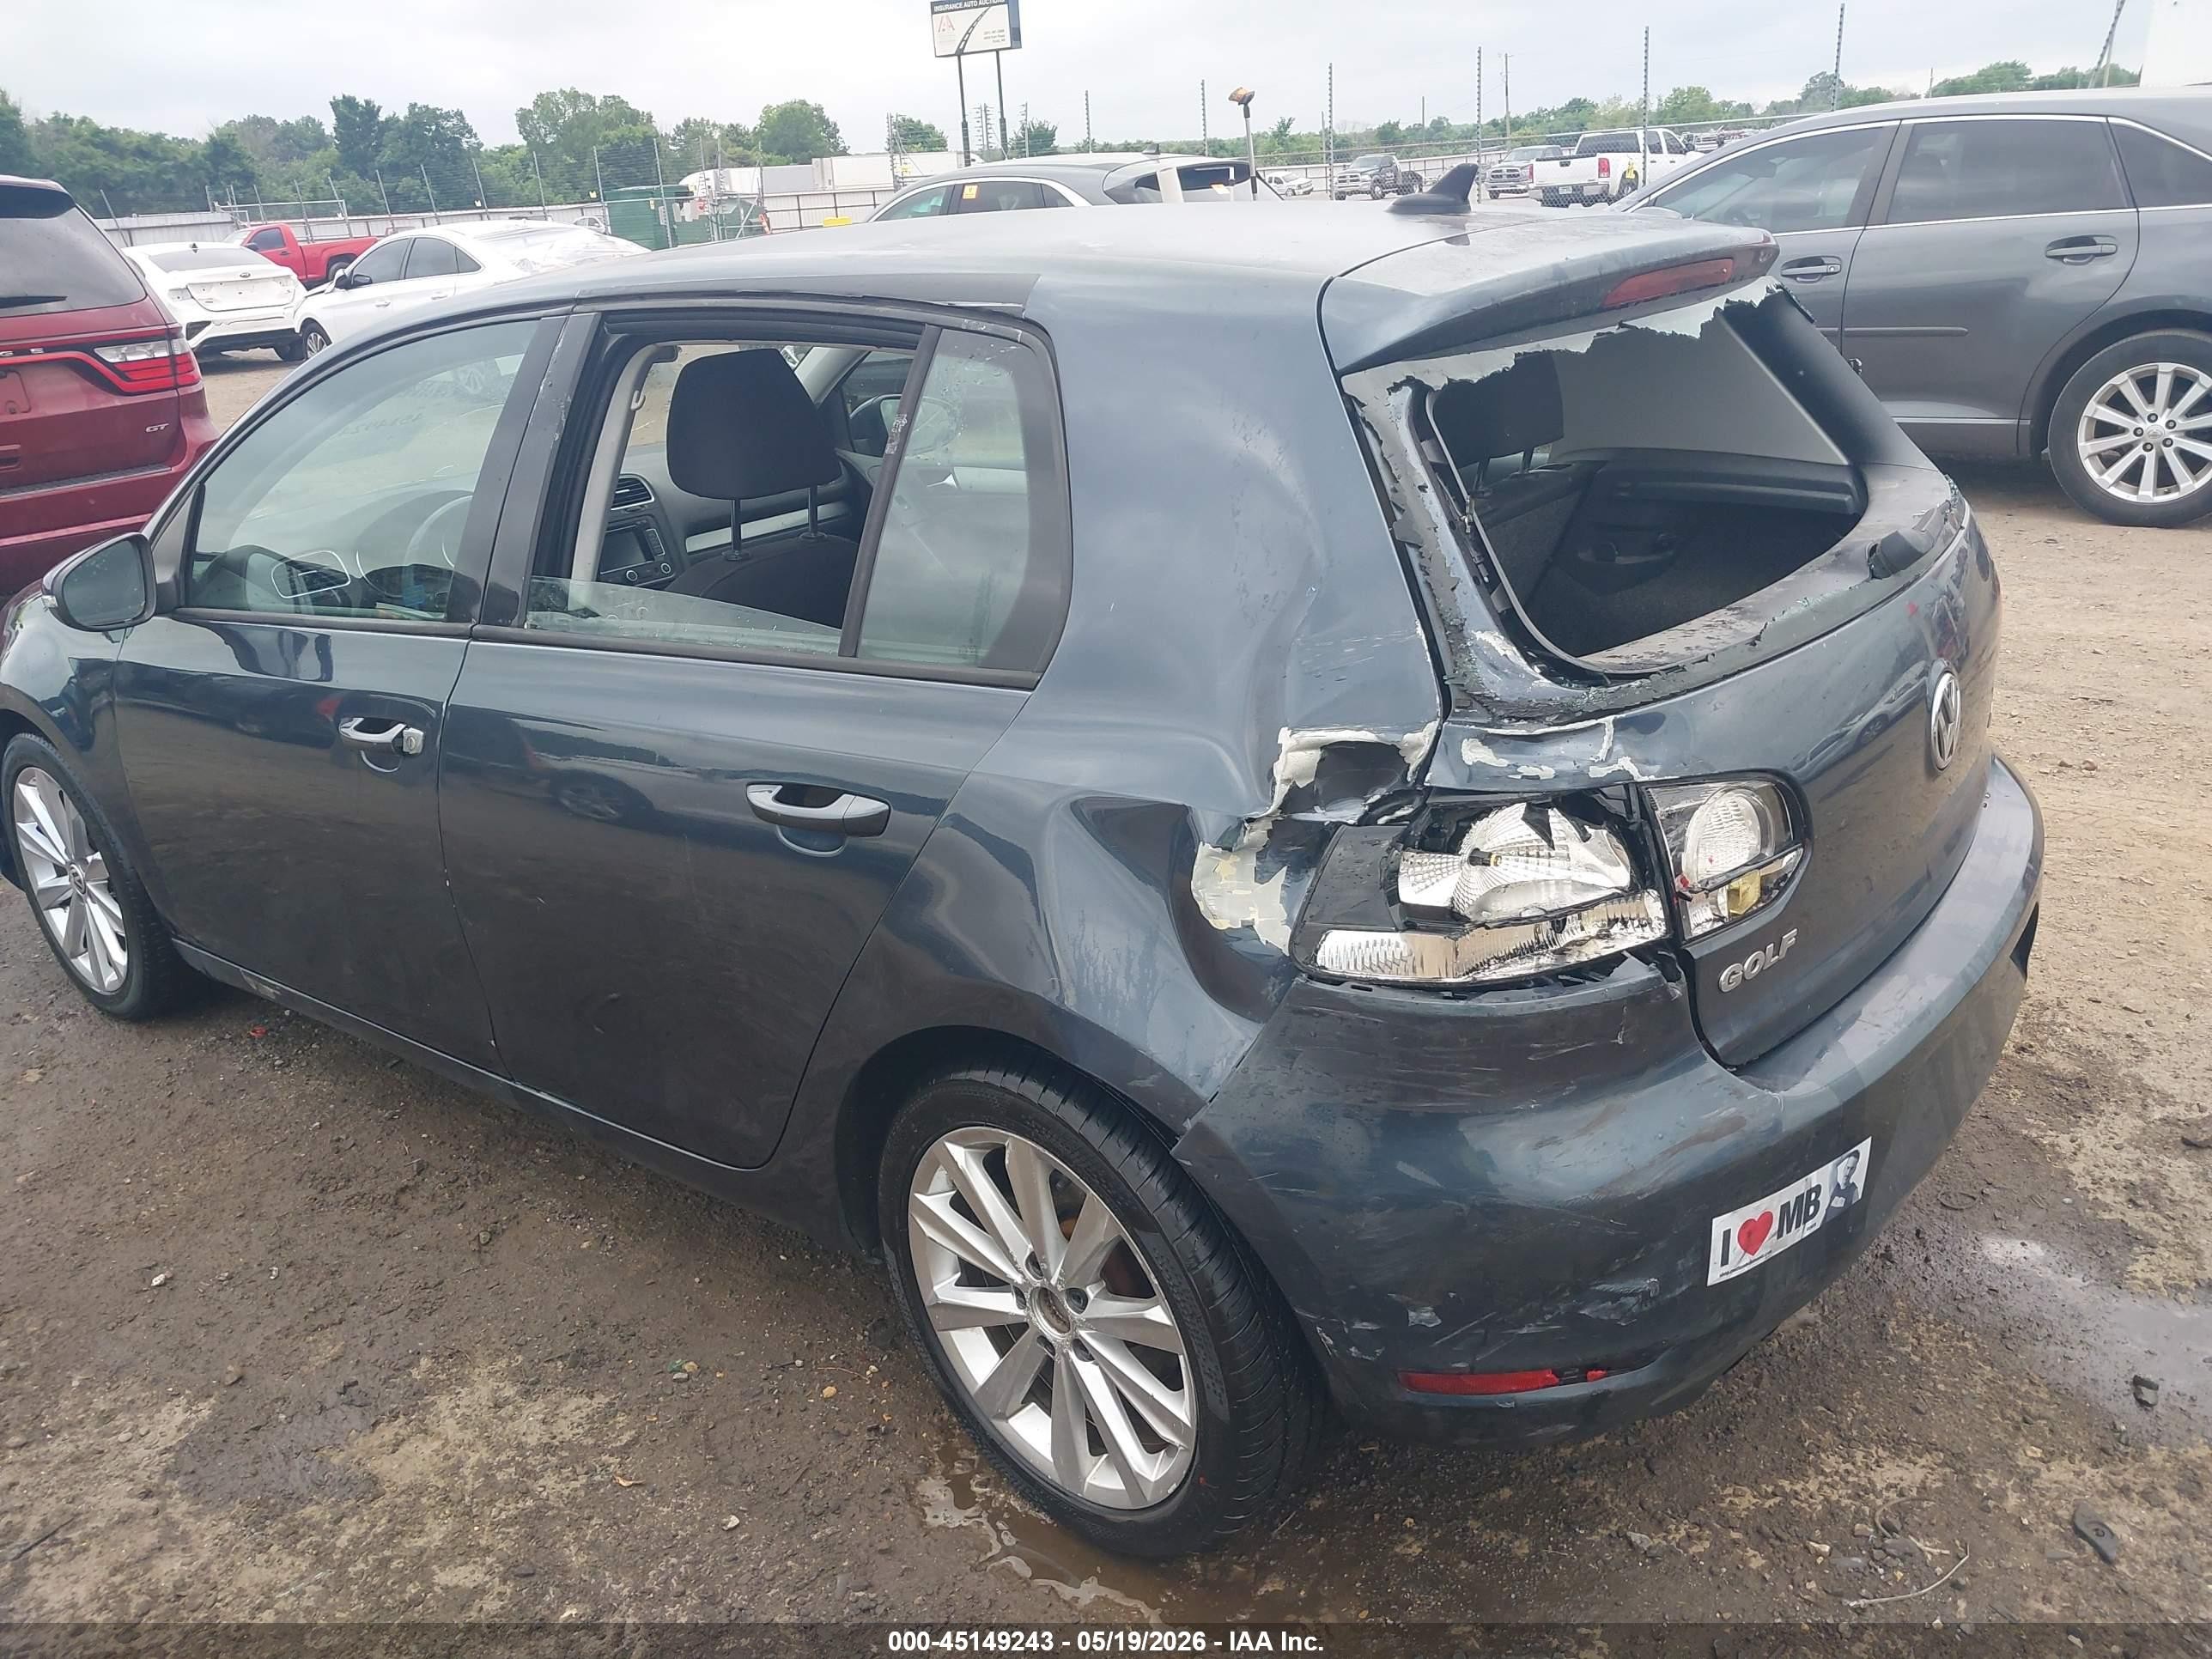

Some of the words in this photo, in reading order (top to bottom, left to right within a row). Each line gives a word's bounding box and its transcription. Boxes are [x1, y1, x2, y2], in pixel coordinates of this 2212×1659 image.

[933, 3, 963, 12] INSURANCE
[145, 422, 170, 433] GT
[1718, 927, 1798, 993] GOLF
[1720, 1228, 1732, 1267] I
[1776, 1183, 1822, 1240] MB
